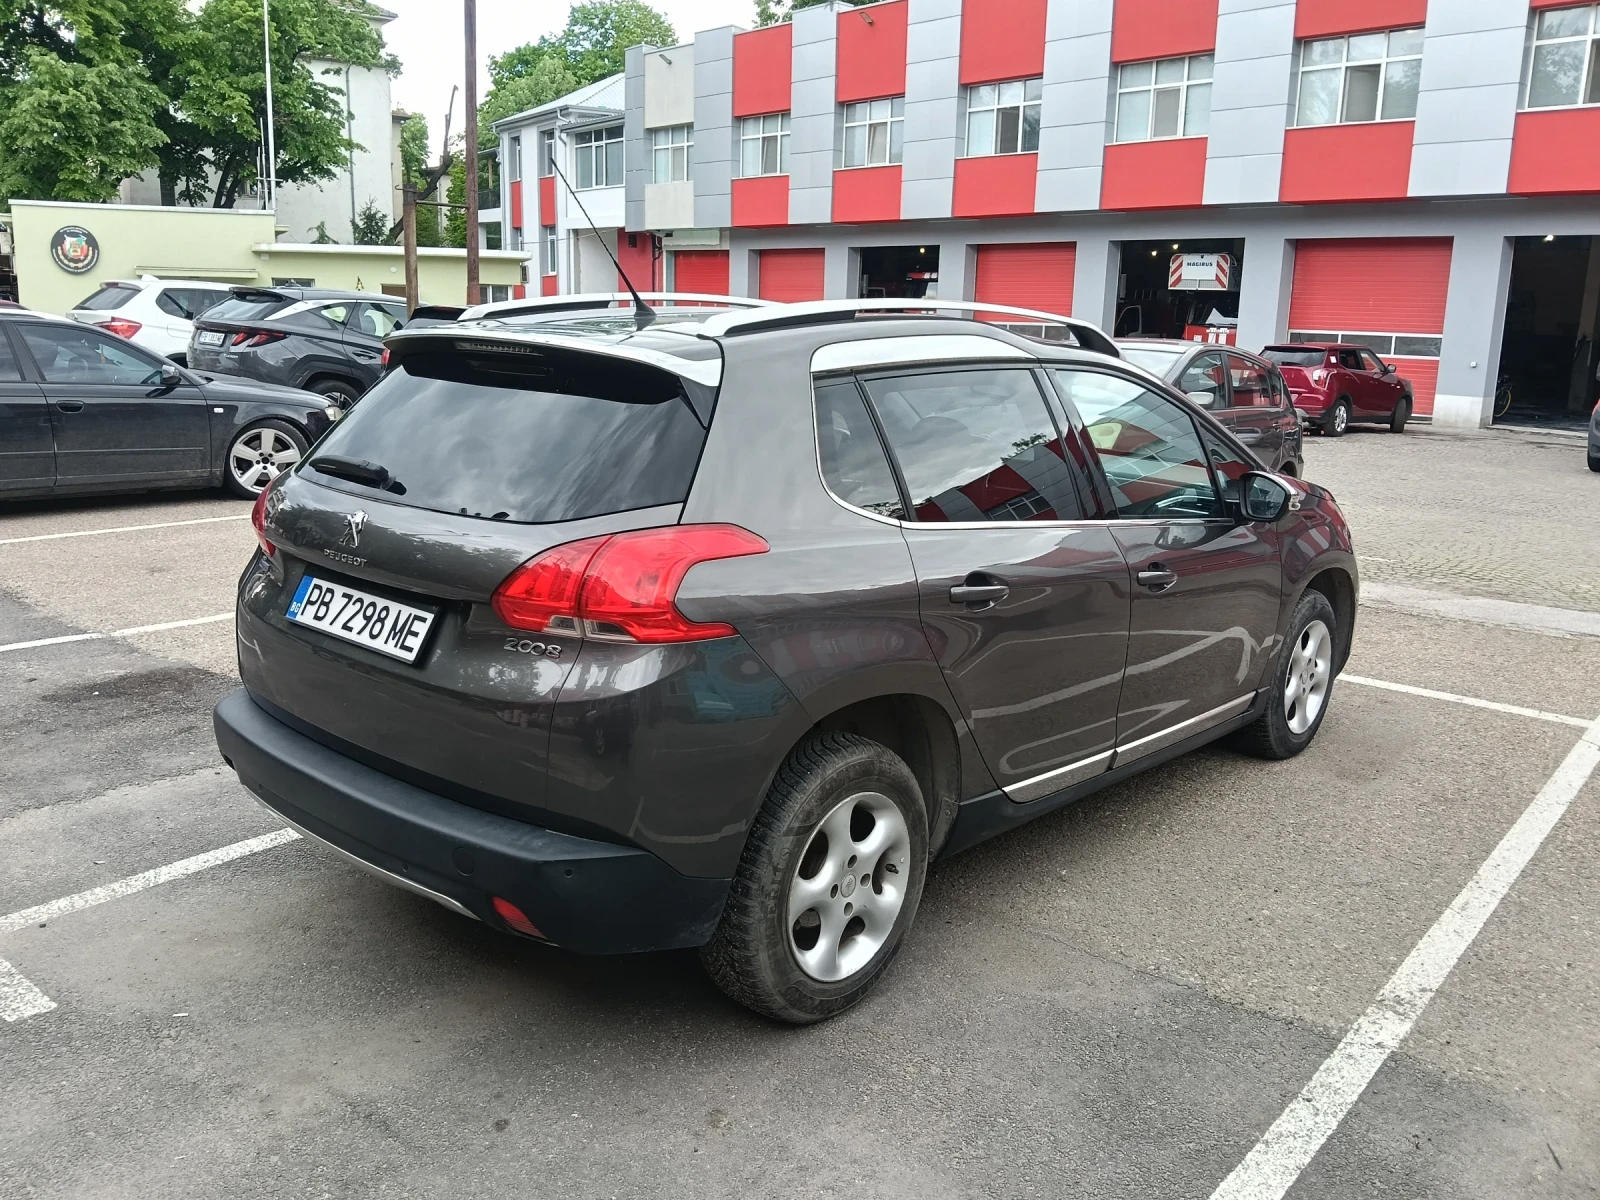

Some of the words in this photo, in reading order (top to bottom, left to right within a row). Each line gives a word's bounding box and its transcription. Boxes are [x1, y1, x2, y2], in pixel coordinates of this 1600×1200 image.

[323, 548, 367, 568] PEUGEOT
[290, 601, 301, 613] BG
[300, 583, 335, 622] PB
[329, 592, 390, 640] 7298
[384, 609, 428, 653] ME
[503, 637, 562, 659] 2008
